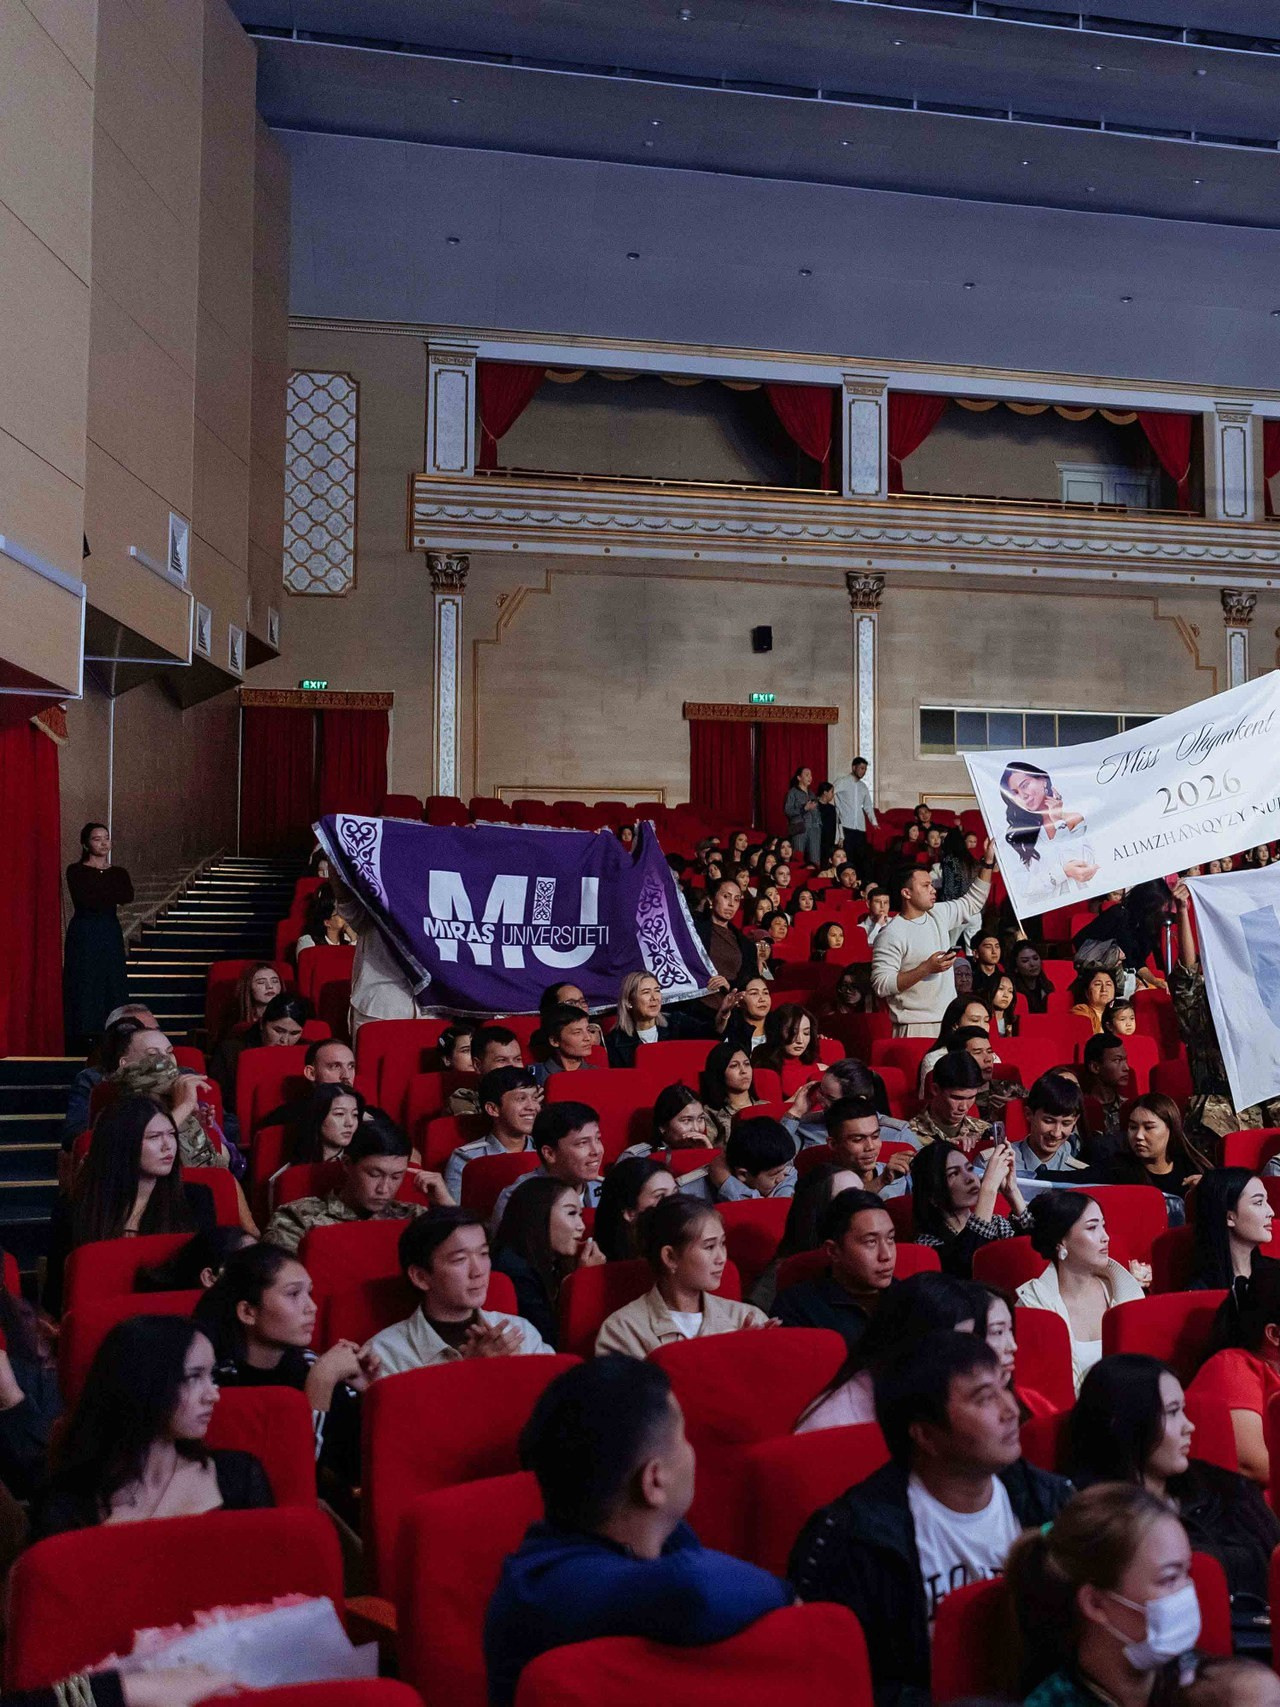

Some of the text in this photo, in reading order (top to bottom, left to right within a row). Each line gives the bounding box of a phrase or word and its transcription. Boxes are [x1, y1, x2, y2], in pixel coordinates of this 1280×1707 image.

[303, 680, 328, 689] EXIT
[752, 693, 774, 703] EXIT
[1097, 709, 1276, 785] Miss Shymkent
[1156, 768, 1242, 814] 2026
[1113, 809, 1247, 861] ALIMZHANQYZY
[423, 916, 610, 946] MIRAS UNIVERSITETI
[429, 870, 599, 969] MU
